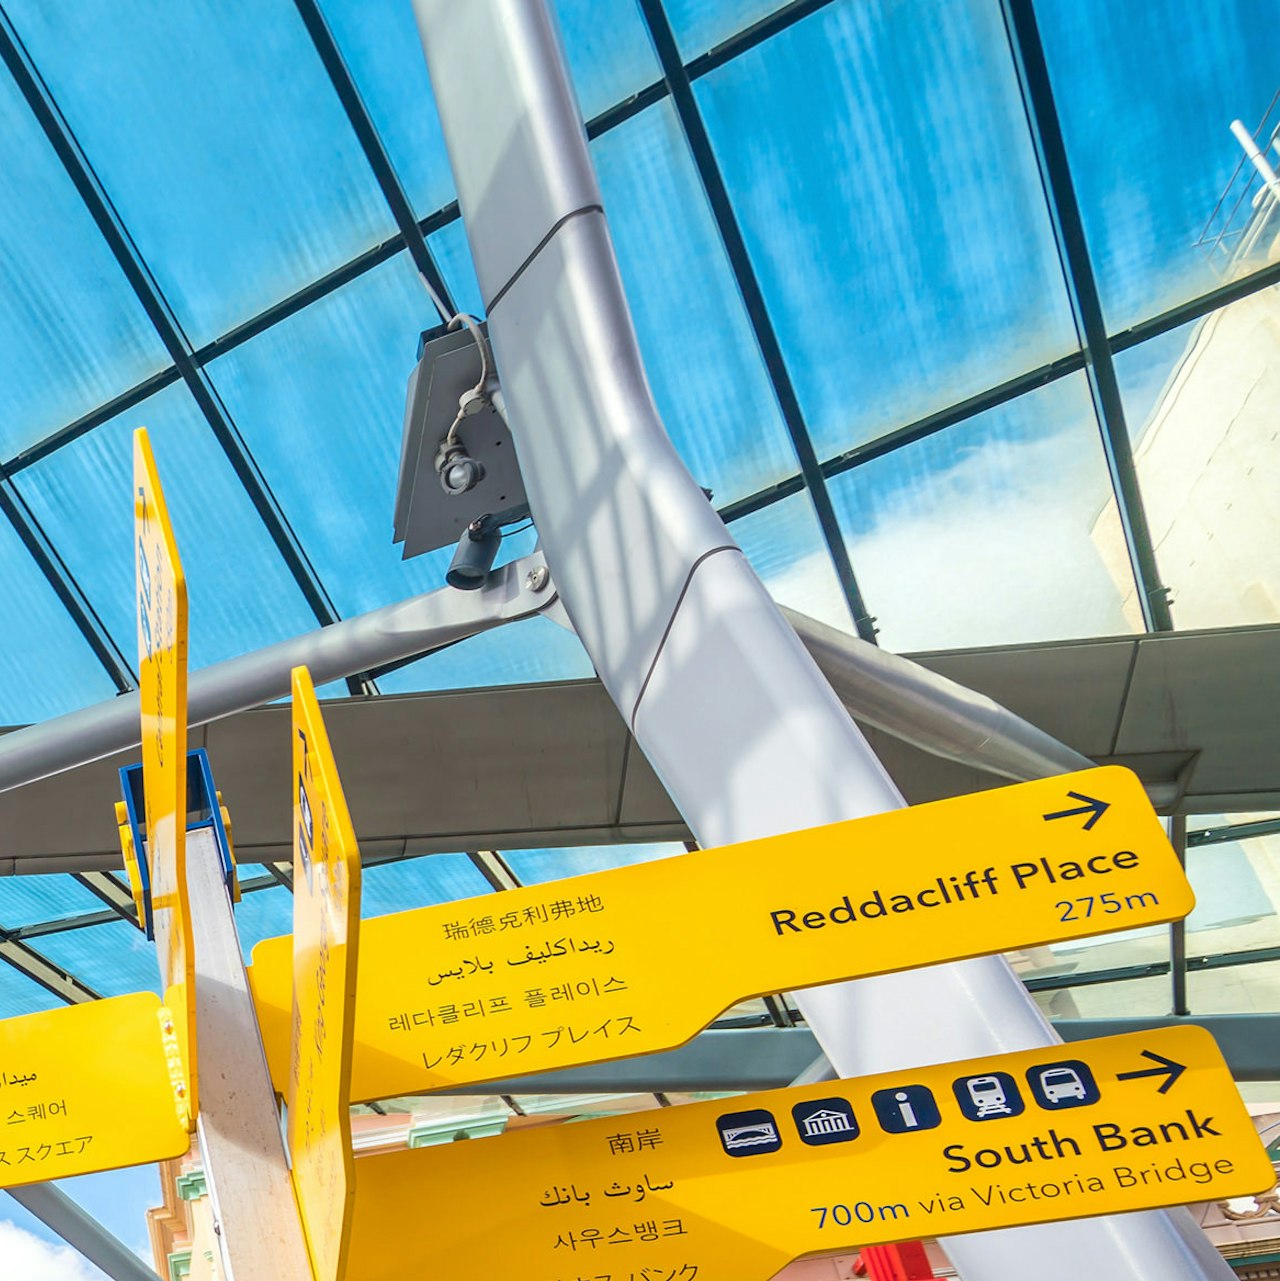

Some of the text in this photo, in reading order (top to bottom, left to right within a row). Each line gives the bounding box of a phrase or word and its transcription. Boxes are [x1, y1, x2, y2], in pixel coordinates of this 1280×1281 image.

[770, 849, 1140, 936] Reddacliff Place
[1054, 889, 1159, 923] 275m
[389, 975, 628, 1033] 레다클리프 플레이스
[423, 1014, 642, 1069] レダクリフ プレイス
[7, 1099, 68, 1127] 스퀘어
[606, 1128, 664, 1155] 南岸
[943, 1109, 1224, 1174] South Bank
[604, 1174, 674, 1202] ساوث
[811, 1157, 1235, 1229] 700m via Victoria Bridge
[553, 1218, 688, 1251] 사우스뱅크
